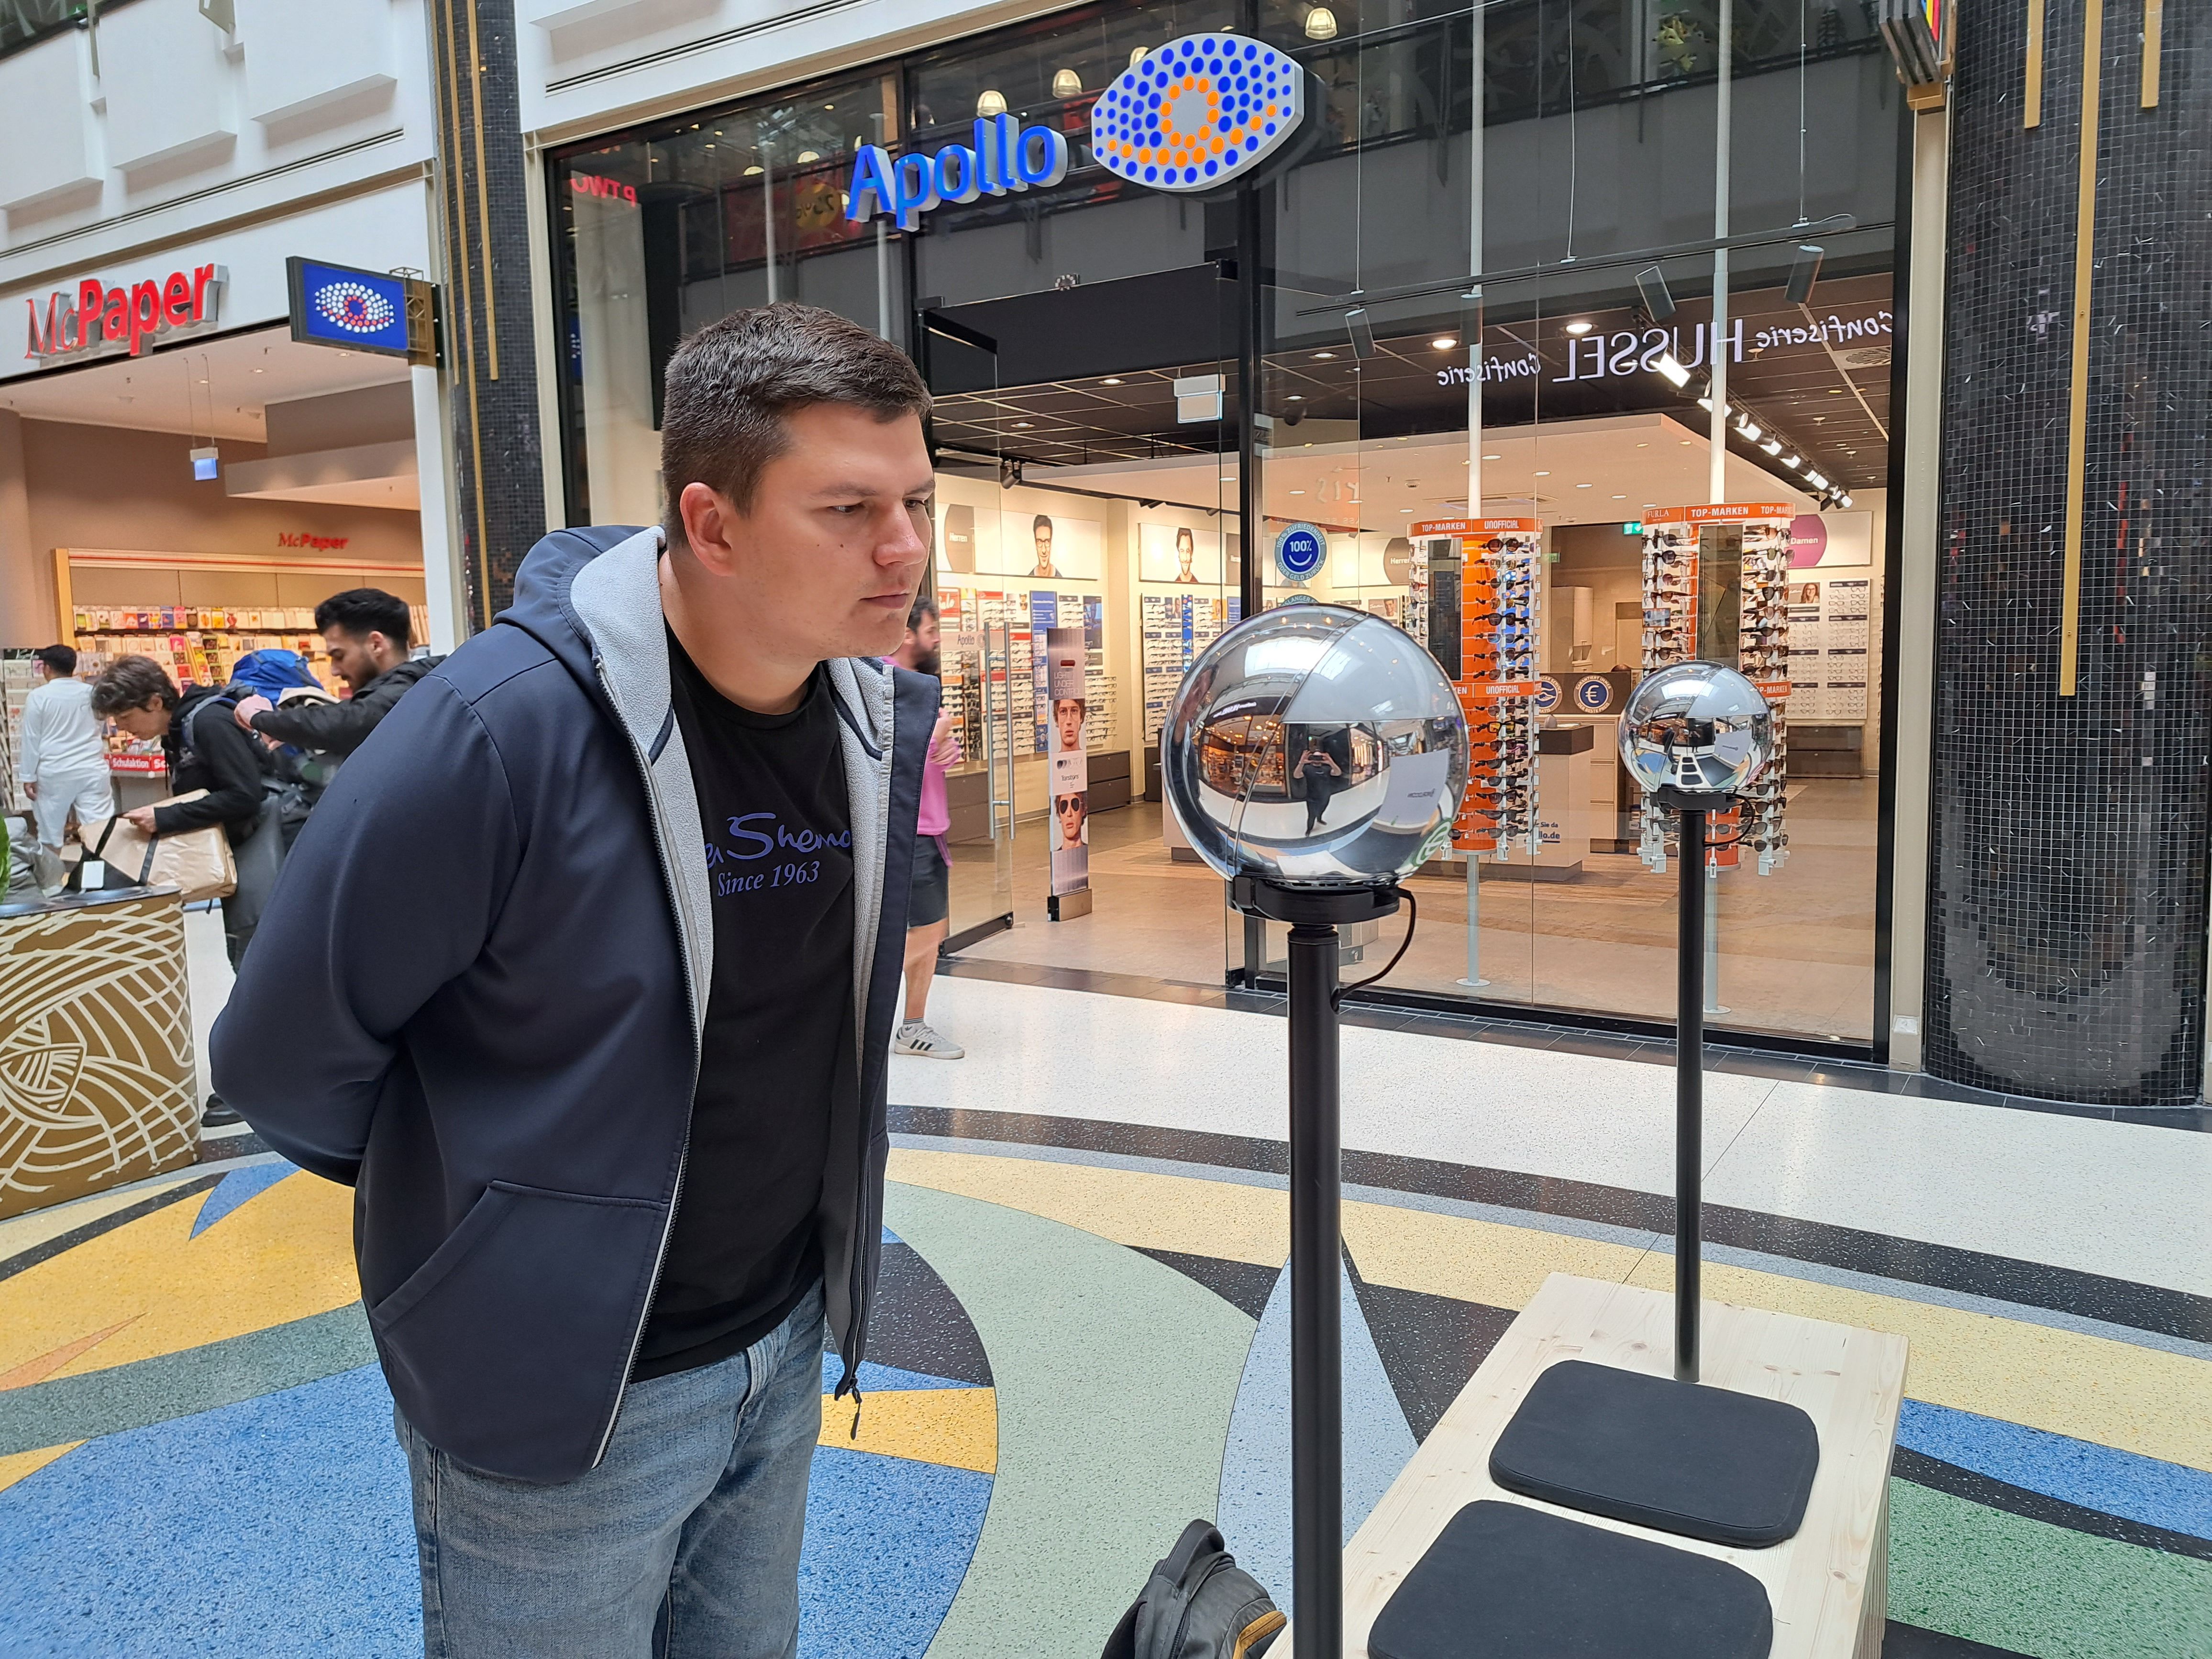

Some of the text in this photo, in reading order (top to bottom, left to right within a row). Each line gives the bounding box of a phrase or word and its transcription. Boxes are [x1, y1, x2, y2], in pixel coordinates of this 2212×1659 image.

[845, 113, 1055, 229] Apollo
[24, 264, 215, 358] McPaper
[1648, 509, 1669, 518] FURLA
[1691, 506, 1749, 518] TOP-MARKEN
[1421, 521, 1466, 532] TOP-MARKEN
[1287, 523, 1325, 546] ZUFRIEDENHEIT
[278, 531, 348, 552] McPaper
[1289, 540, 1313, 553] 100%
[1277, 562, 1290, 577] ODER
[1281, 595, 1310, 608] SLANGER
[957, 633, 975, 646] Apollo
[1757, 685, 1788, 694] P-MARKEN
[112, 757, 149, 769] Schulaktion
[718, 861, 820, 897] Since 1963
